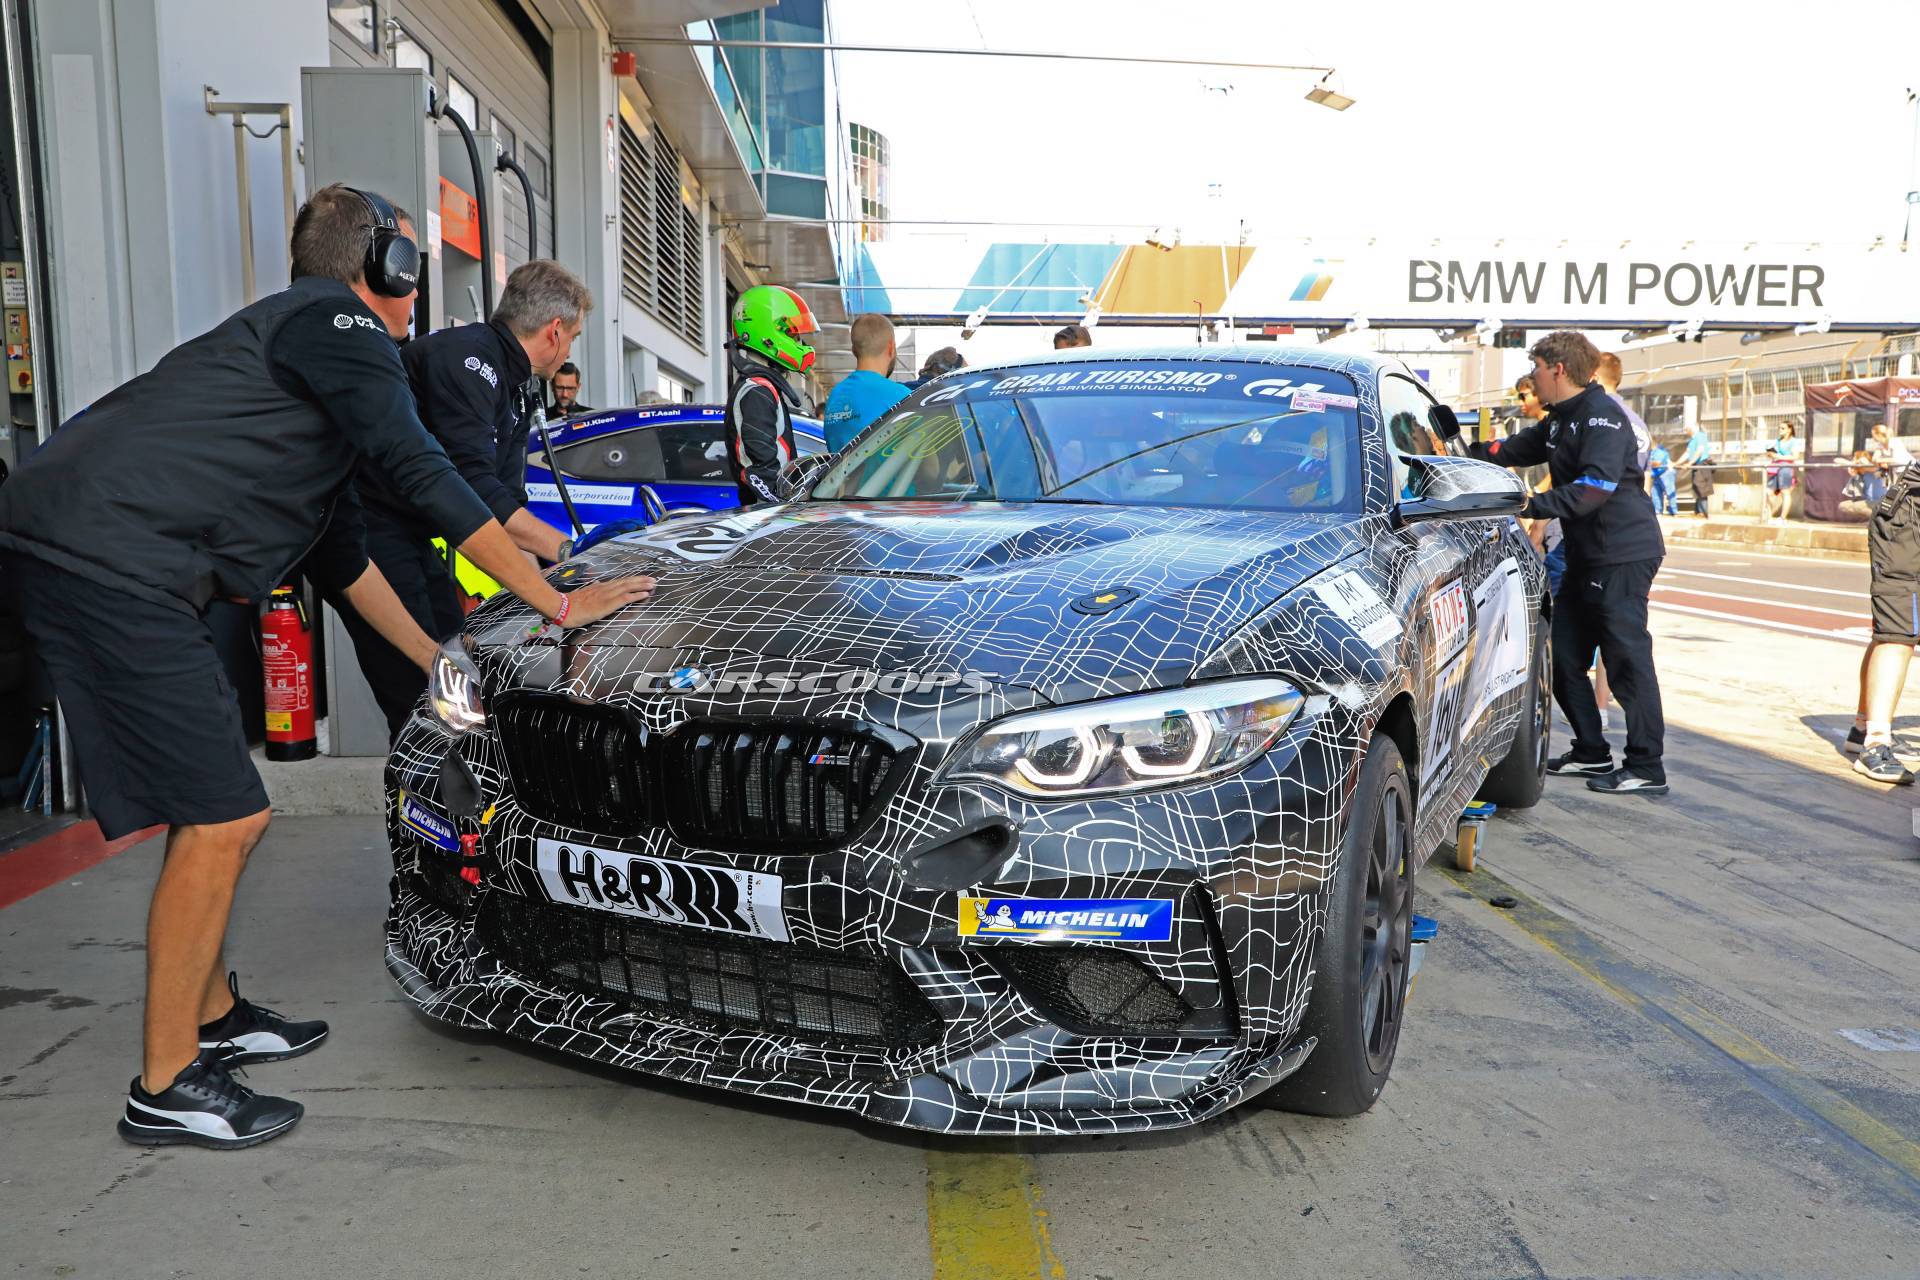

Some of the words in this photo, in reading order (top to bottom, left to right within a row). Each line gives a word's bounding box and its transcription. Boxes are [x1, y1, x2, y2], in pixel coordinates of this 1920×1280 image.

[1408, 259, 1547, 304] BMW
[1563, 262, 1608, 305] M
[1627, 262, 1826, 308] POWER
[988, 389, 1014, 397] THE
[1016, 386, 1054, 394] REAL
[1055, 384, 1113, 393] DRIVING
[1115, 383, 1208, 393] SIMULATOR
[991, 371, 1083, 391] GRAN
[1081, 369, 1227, 386] TURISMO
[583, 416, 616, 427] U.Kleen
[650, 409, 681, 417] T.Asahi
[527, 486, 560, 497] Senko
[1347, 601, 1391, 632] solutions
[1433, 587, 1465, 641] ROWE
[409, 807, 452, 839] MICHELIN
[1019, 910, 1149, 928] MICHELIN
